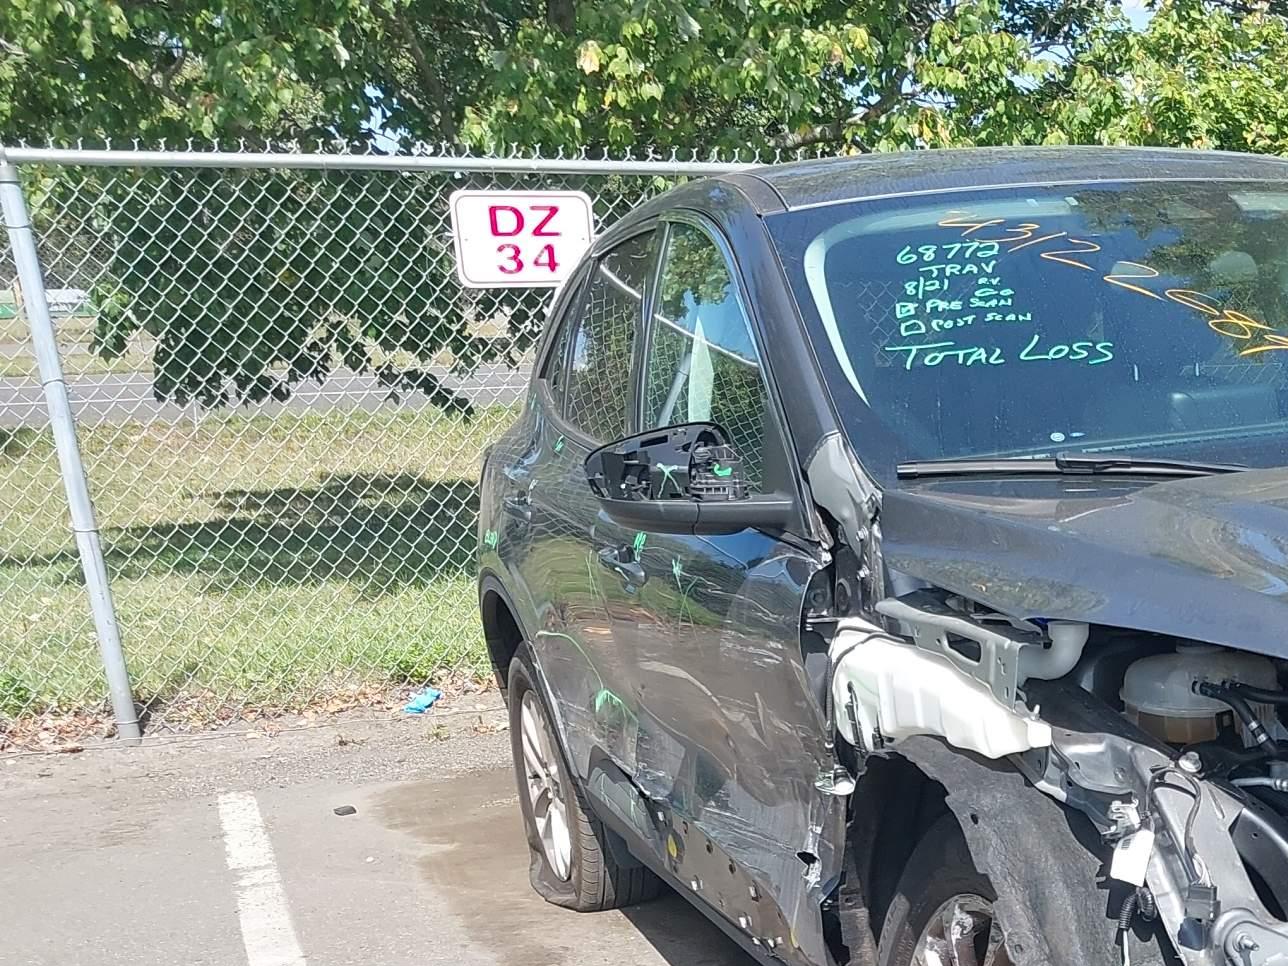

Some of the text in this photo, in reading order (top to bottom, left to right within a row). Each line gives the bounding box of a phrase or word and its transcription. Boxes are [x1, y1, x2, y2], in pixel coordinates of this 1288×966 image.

[488, 205, 562, 237] DZ
[496, 243, 560, 275] 34
[896, 240, 1001, 265] 68772
